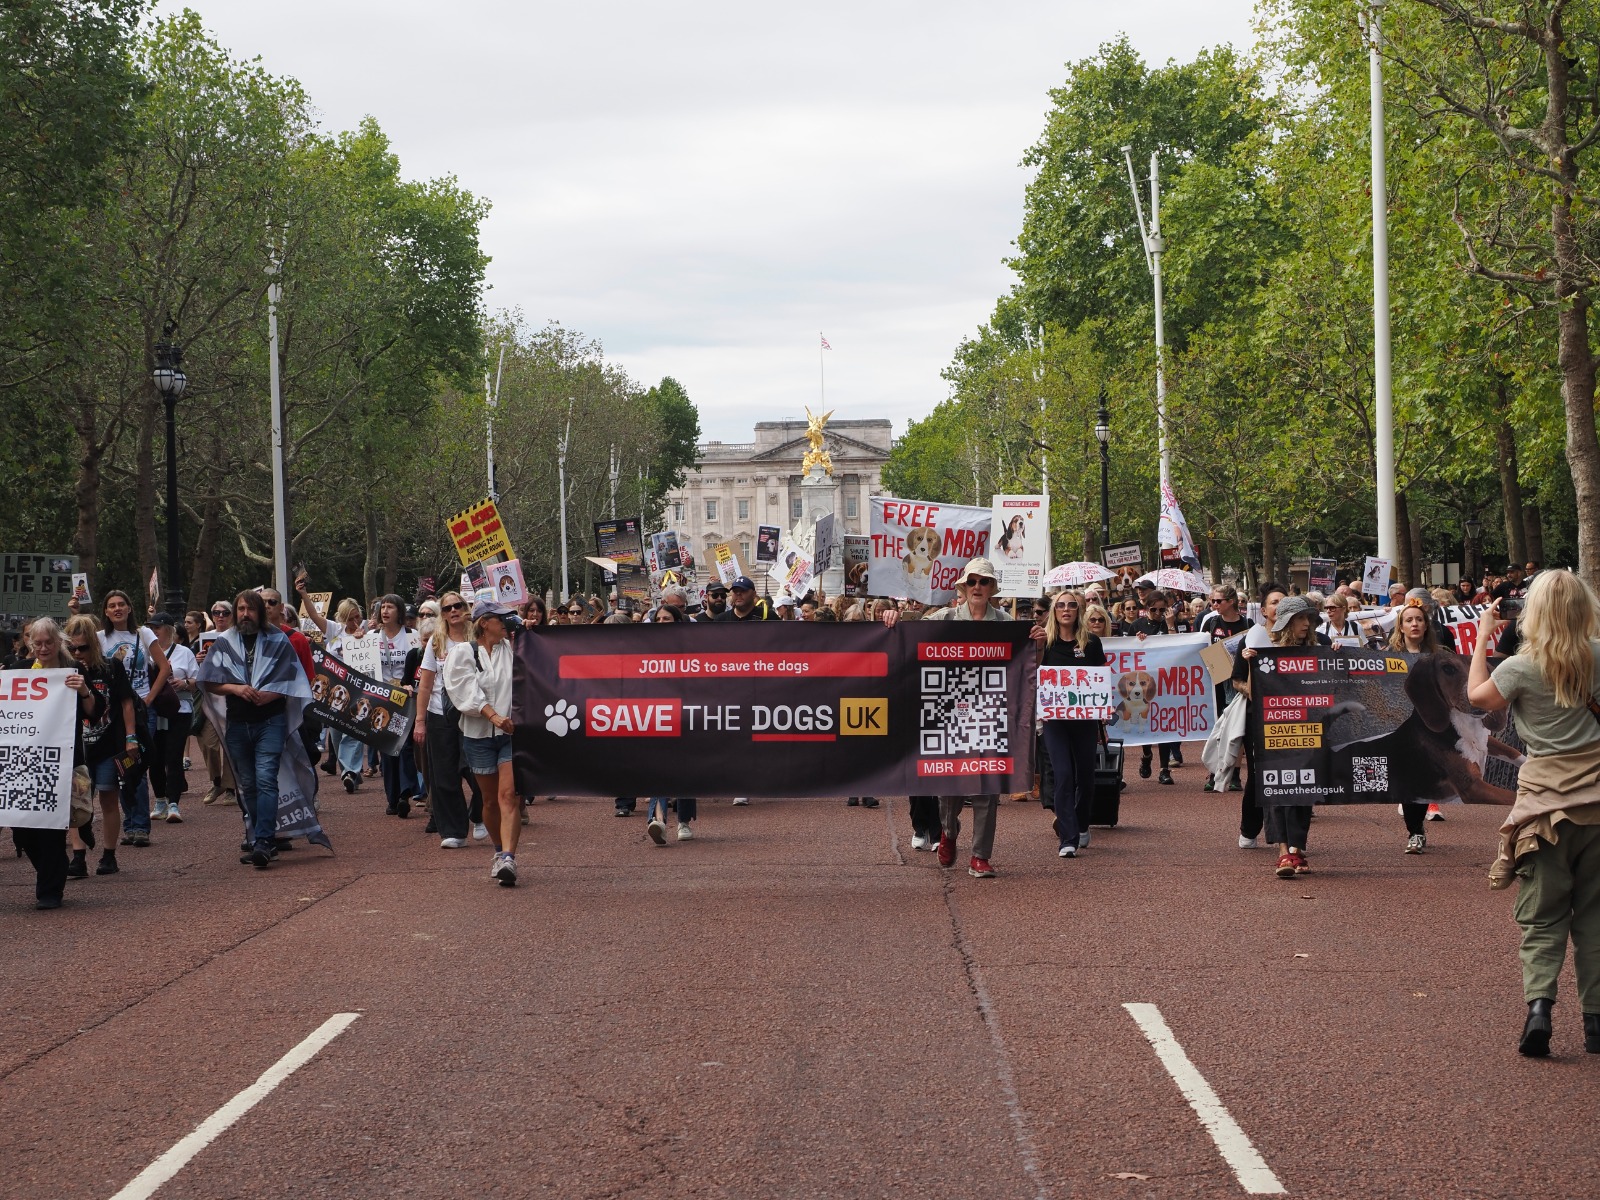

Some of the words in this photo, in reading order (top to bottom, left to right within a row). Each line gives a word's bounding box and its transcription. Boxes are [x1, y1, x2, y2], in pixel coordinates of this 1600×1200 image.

[883, 502, 940, 528] FREE
[467, 542, 486, 555] RUNNING
[870, 534, 904, 560] THE
[942, 528, 989, 558] MBR
[467, 555, 476, 563] ALL
[476, 548, 489, 560] YEAR
[815, 552, 824, 564] LET
[4, 556, 45, 573] LET
[3, 575, 35, 592] ME
[42, 576, 70, 593] BE
[2, 593, 63, 612] FREE
[346, 638, 378, 651] CLOSE
[352, 654, 370, 662] MBR
[926, 646, 964, 658] CLOSE
[969, 646, 1005, 658] DOWN
[352, 664, 376, 672] CRES
[639, 660, 676, 673] JOIN
[680, 659, 700, 673] US
[704, 661, 718, 672] to
[721, 662, 750, 671] save
[753, 660, 773, 671] the
[778, 660, 809, 674] dogs
[1104, 652, 1146, 674] REE
[1279, 660, 1314, 672] SAVE
[1318, 659, 1344, 670] THE
[1348, 659, 1385, 671] DOGS
[1389, 660, 1404, 670] UK
[324, 658, 344, 678] SAVE
[345, 671, 363, 690] THE
[363, 682, 390, 699] DOGS
[392, 692, 404, 704] UK
[1040, 668, 1090, 686] MBR
[1094, 673, 1104, 682] is
[1158, 665, 1204, 696] MBR
[1068, 691, 1108, 706] Dirty
[1268, 698, 1303, 707] CLOSE
[1305, 697, 1329, 706] MBR
[0, 710, 33, 719] Acres
[590, 704, 673, 732] SAVE
[683, 705, 741, 731] THE
[751, 705, 834, 731] DOGS
[846, 706, 881, 729] UK
[1043, 706, 1111, 719] SECRET!
[1151, 696, 1208, 737] Beagles
[1267, 710, 1301, 720] ACRES
[1270, 726, 1296, 735] SAVE
[1300, 724, 1319, 734] THE
[1268, 738, 1315, 748] BEAGLES
[924, 762, 954, 774] MBR
[960, 760, 1007, 772] ACRES
[1263, 786, 1345, 797] @savethedogsuk
